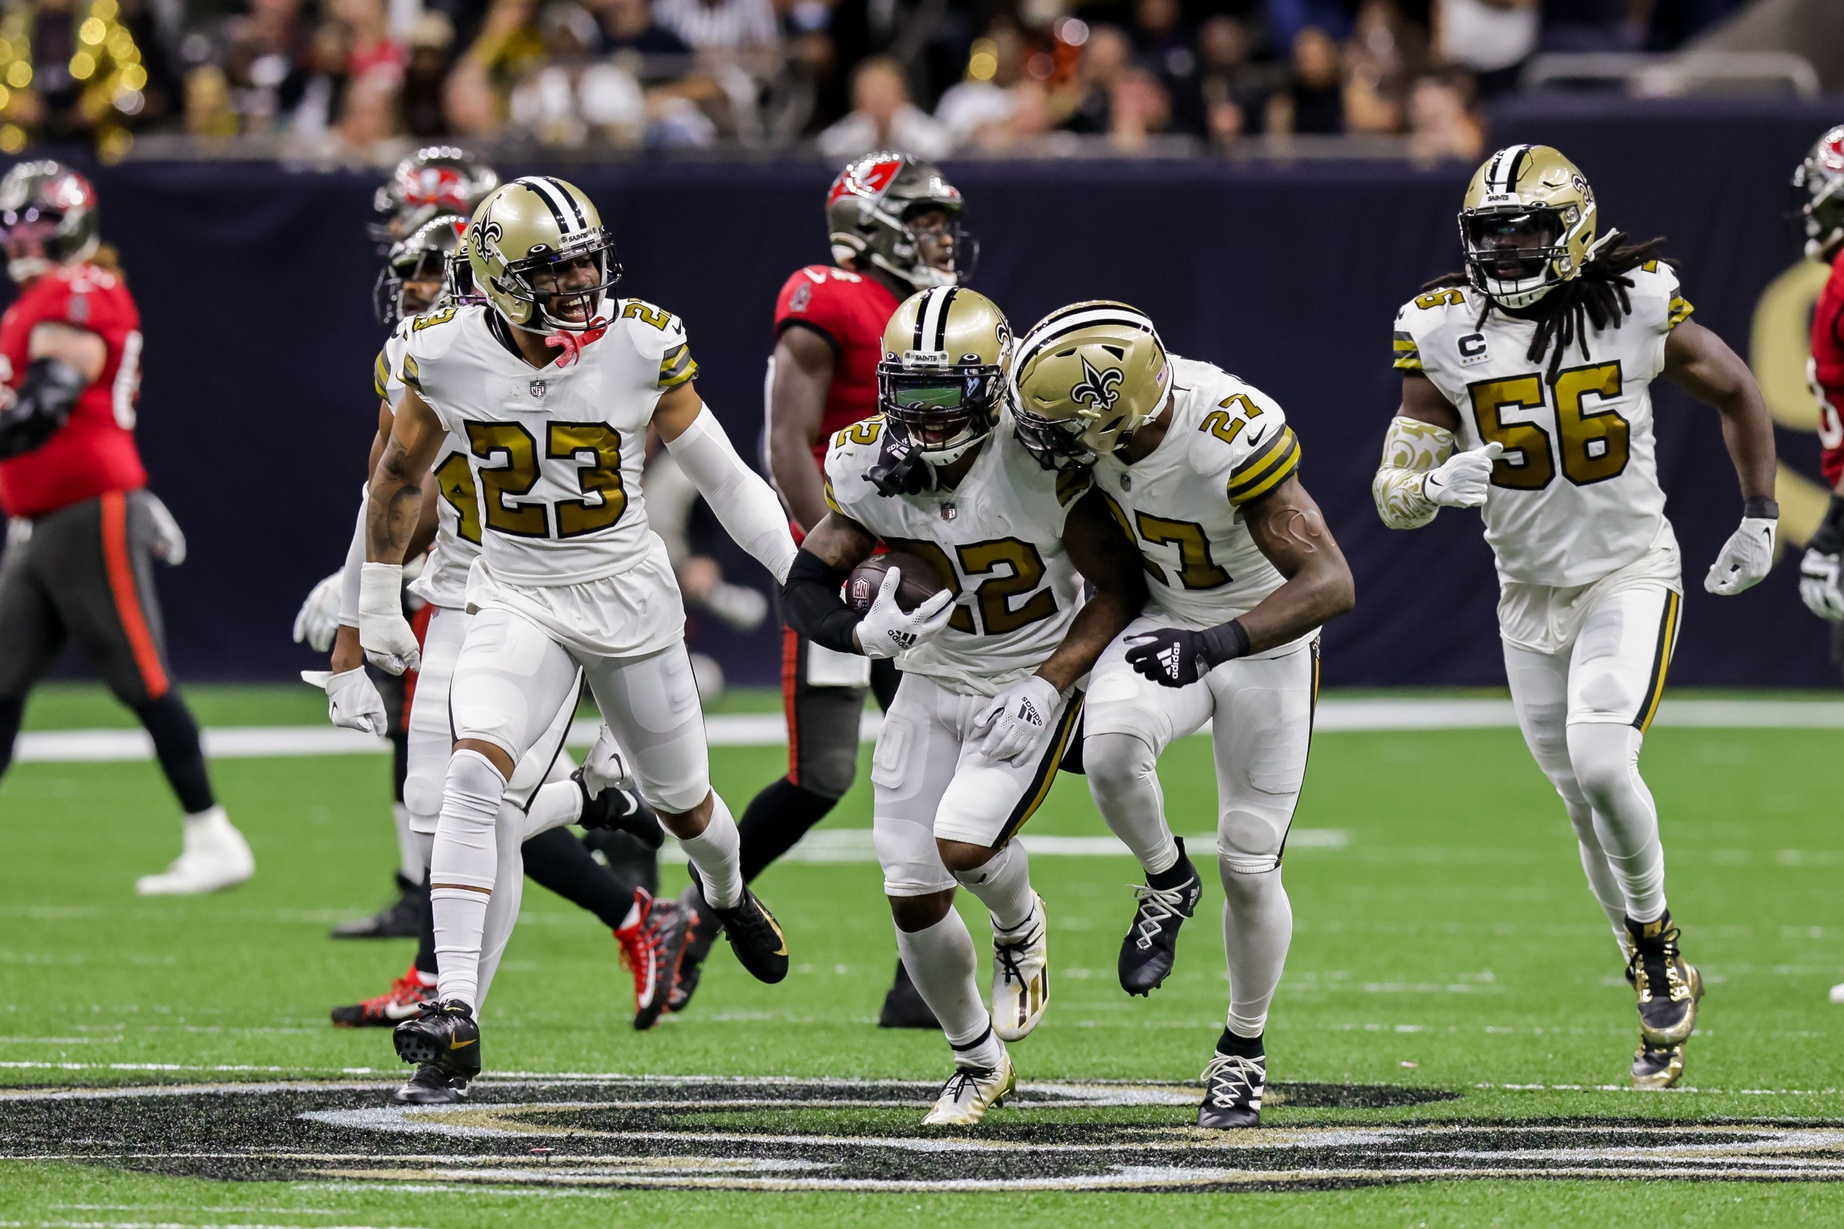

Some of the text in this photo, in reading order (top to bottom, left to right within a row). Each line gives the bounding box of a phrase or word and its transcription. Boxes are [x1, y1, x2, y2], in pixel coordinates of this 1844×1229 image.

[1488, 194, 1509, 202] SAINTS
[1415, 288, 1466, 310] 6
[915, 354, 938, 362] SAINTS
[1458, 333, 1487, 358] C
[835, 412, 887, 450] 2
[1198, 392, 1264, 445] 27
[1466, 359, 1631, 491] 56
[463, 419, 628, 539] 23
[1102, 488, 1234, 591] 7
[887, 629, 911, 651] adidas
[1171, 641, 1181, 680] adidas
[1021, 696, 1043, 727] adidas
